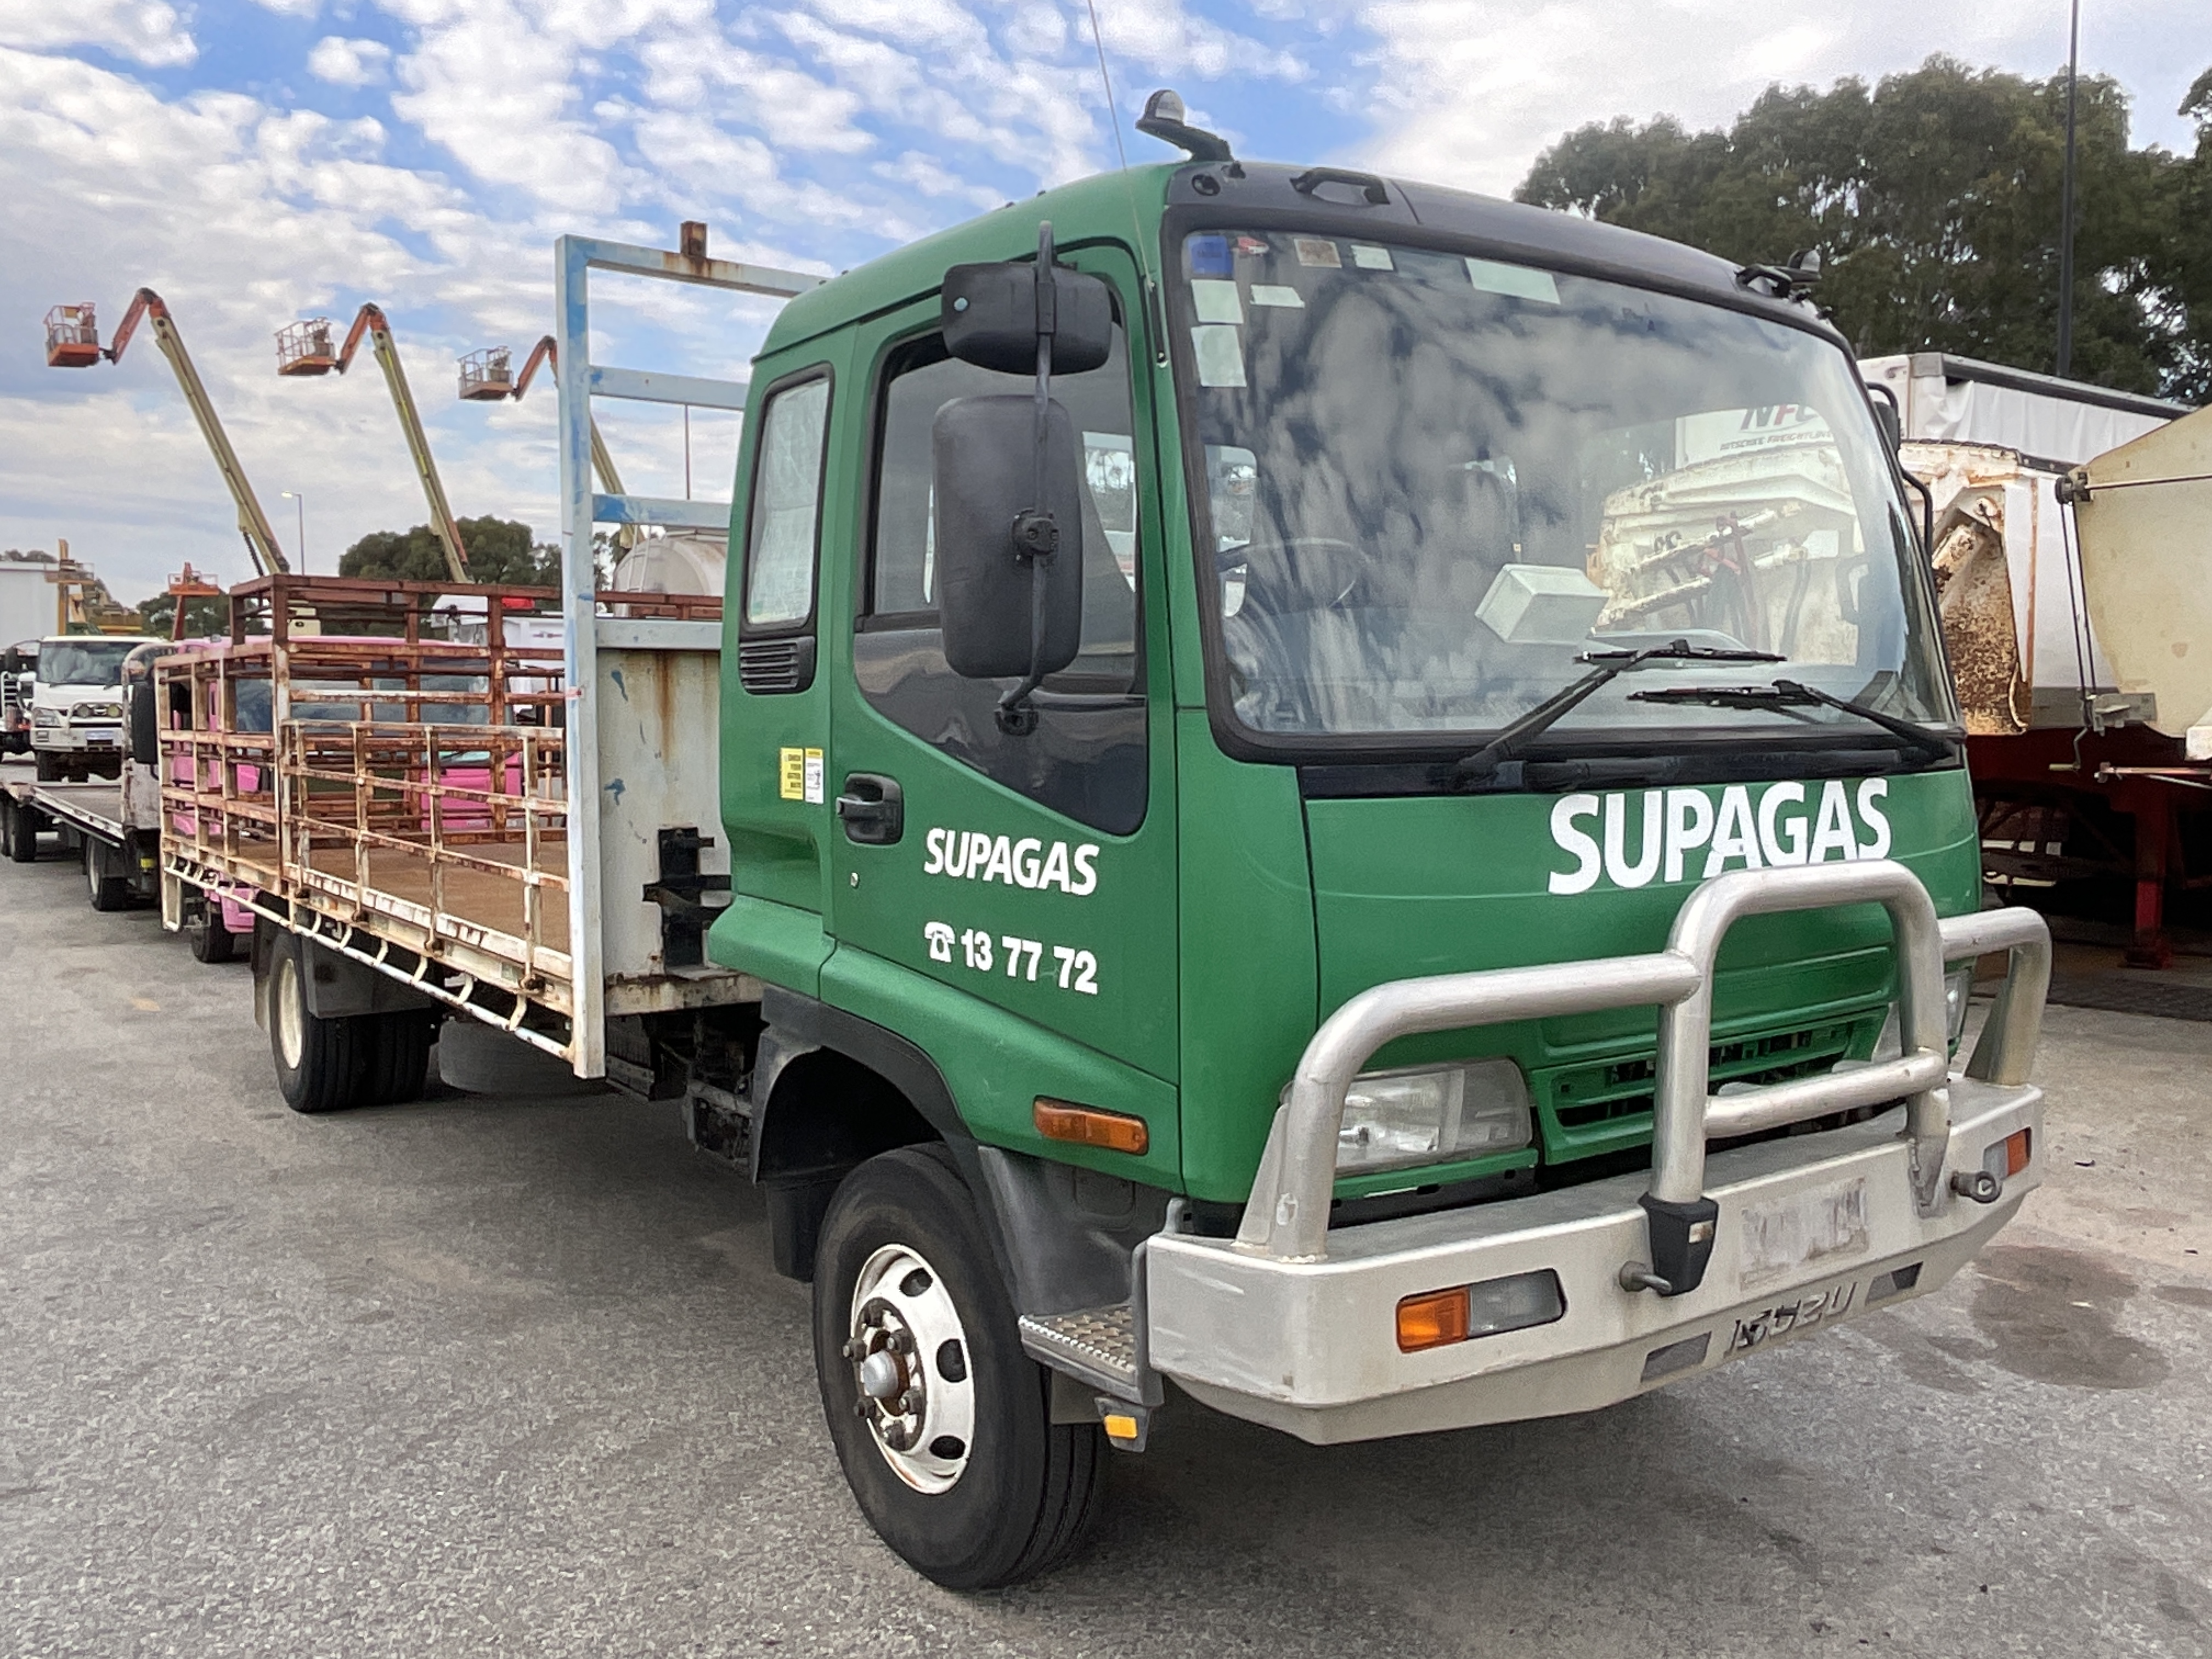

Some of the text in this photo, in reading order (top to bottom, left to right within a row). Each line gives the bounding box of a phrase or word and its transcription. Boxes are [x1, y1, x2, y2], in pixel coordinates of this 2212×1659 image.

[924, 827, 1100, 896] SUPAGAS
[1548, 777, 1892, 895] SUPAGAS
[961, 928, 1098, 995] 13 77 72
[1723, 1282, 1858, 1358] ISUZU
